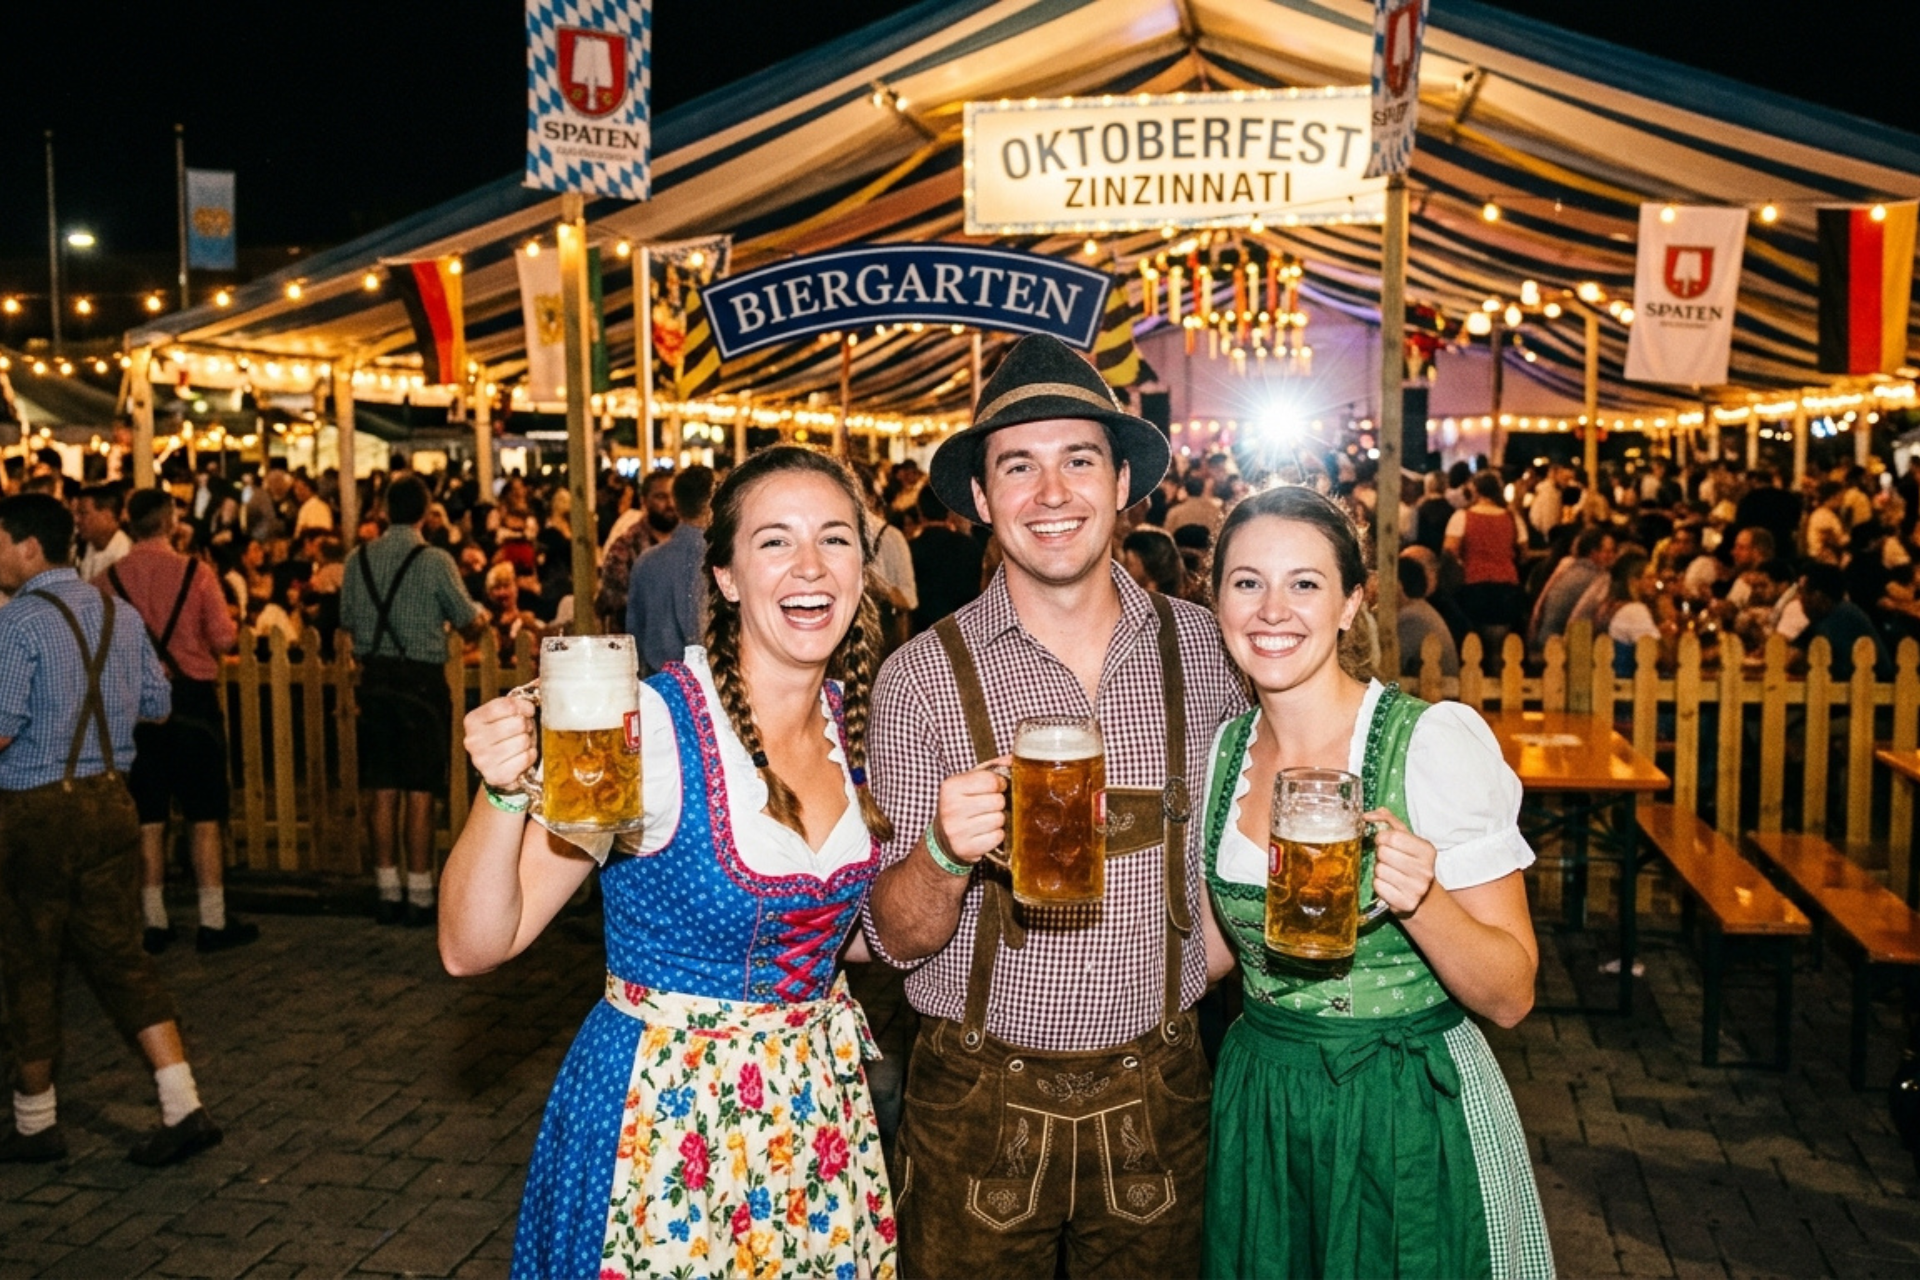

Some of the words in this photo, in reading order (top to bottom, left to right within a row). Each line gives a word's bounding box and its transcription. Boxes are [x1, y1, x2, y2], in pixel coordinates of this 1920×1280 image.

[544, 121, 640, 149] SPATEN
[1001, 117, 1363, 180] OKTOBERFEST
[1065, 171, 1292, 208] ZINZINNATI
[728, 262, 1083, 334] BIERGARTEN
[1645, 303, 1723, 321] SPATEN
